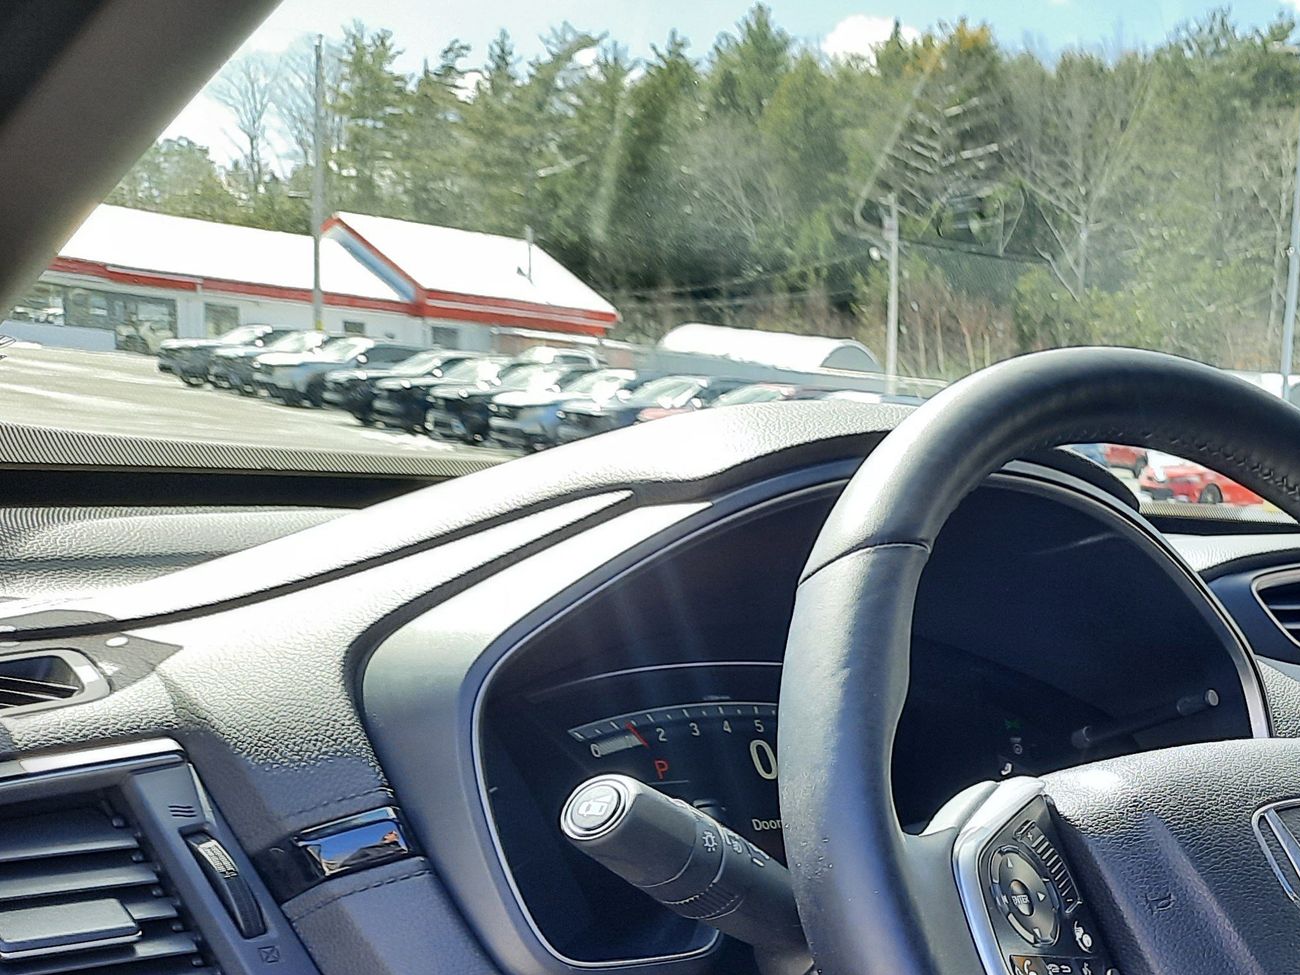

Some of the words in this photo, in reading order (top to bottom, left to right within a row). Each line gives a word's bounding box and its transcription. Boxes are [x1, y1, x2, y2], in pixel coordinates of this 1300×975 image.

[656, 728, 668, 741] 2
[689, 722, 700, 736] 3
[723, 720, 732, 733] 4
[754, 719, 764, 732] 5
[654, 760, 669, 780] P
[749, 740, 778, 780] 0
